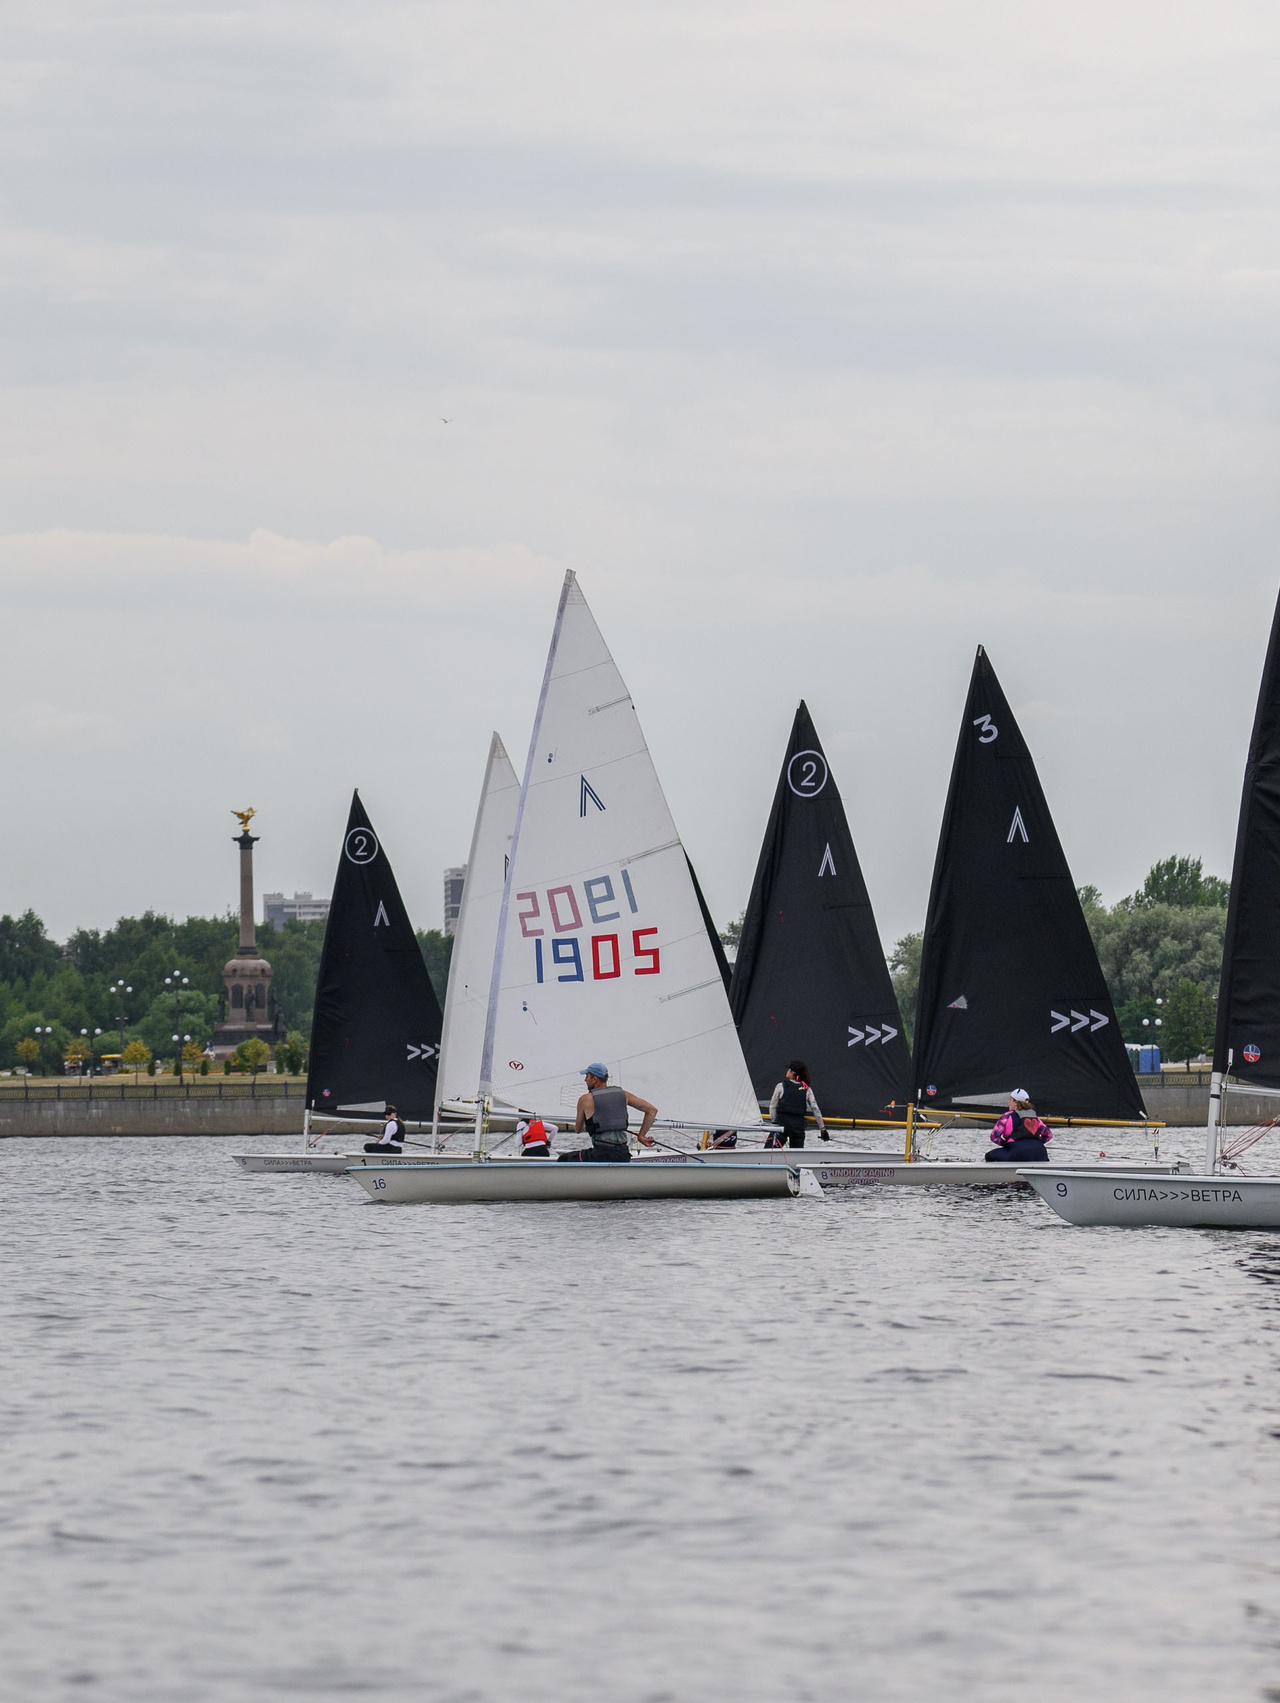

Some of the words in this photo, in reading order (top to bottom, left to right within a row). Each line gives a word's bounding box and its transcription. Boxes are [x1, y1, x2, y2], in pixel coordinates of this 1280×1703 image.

[973, 713, 998, 744] 3
[801, 760, 816, 787] 2
[354, 835, 368, 857] 2
[535, 927, 660, 983] 1905
[360, 1158, 367, 1166] 1
[372, 1178, 387, 1190] 16
[821, 1171, 828, 1180] 8
[1056, 1182, 1068, 1198] 9
